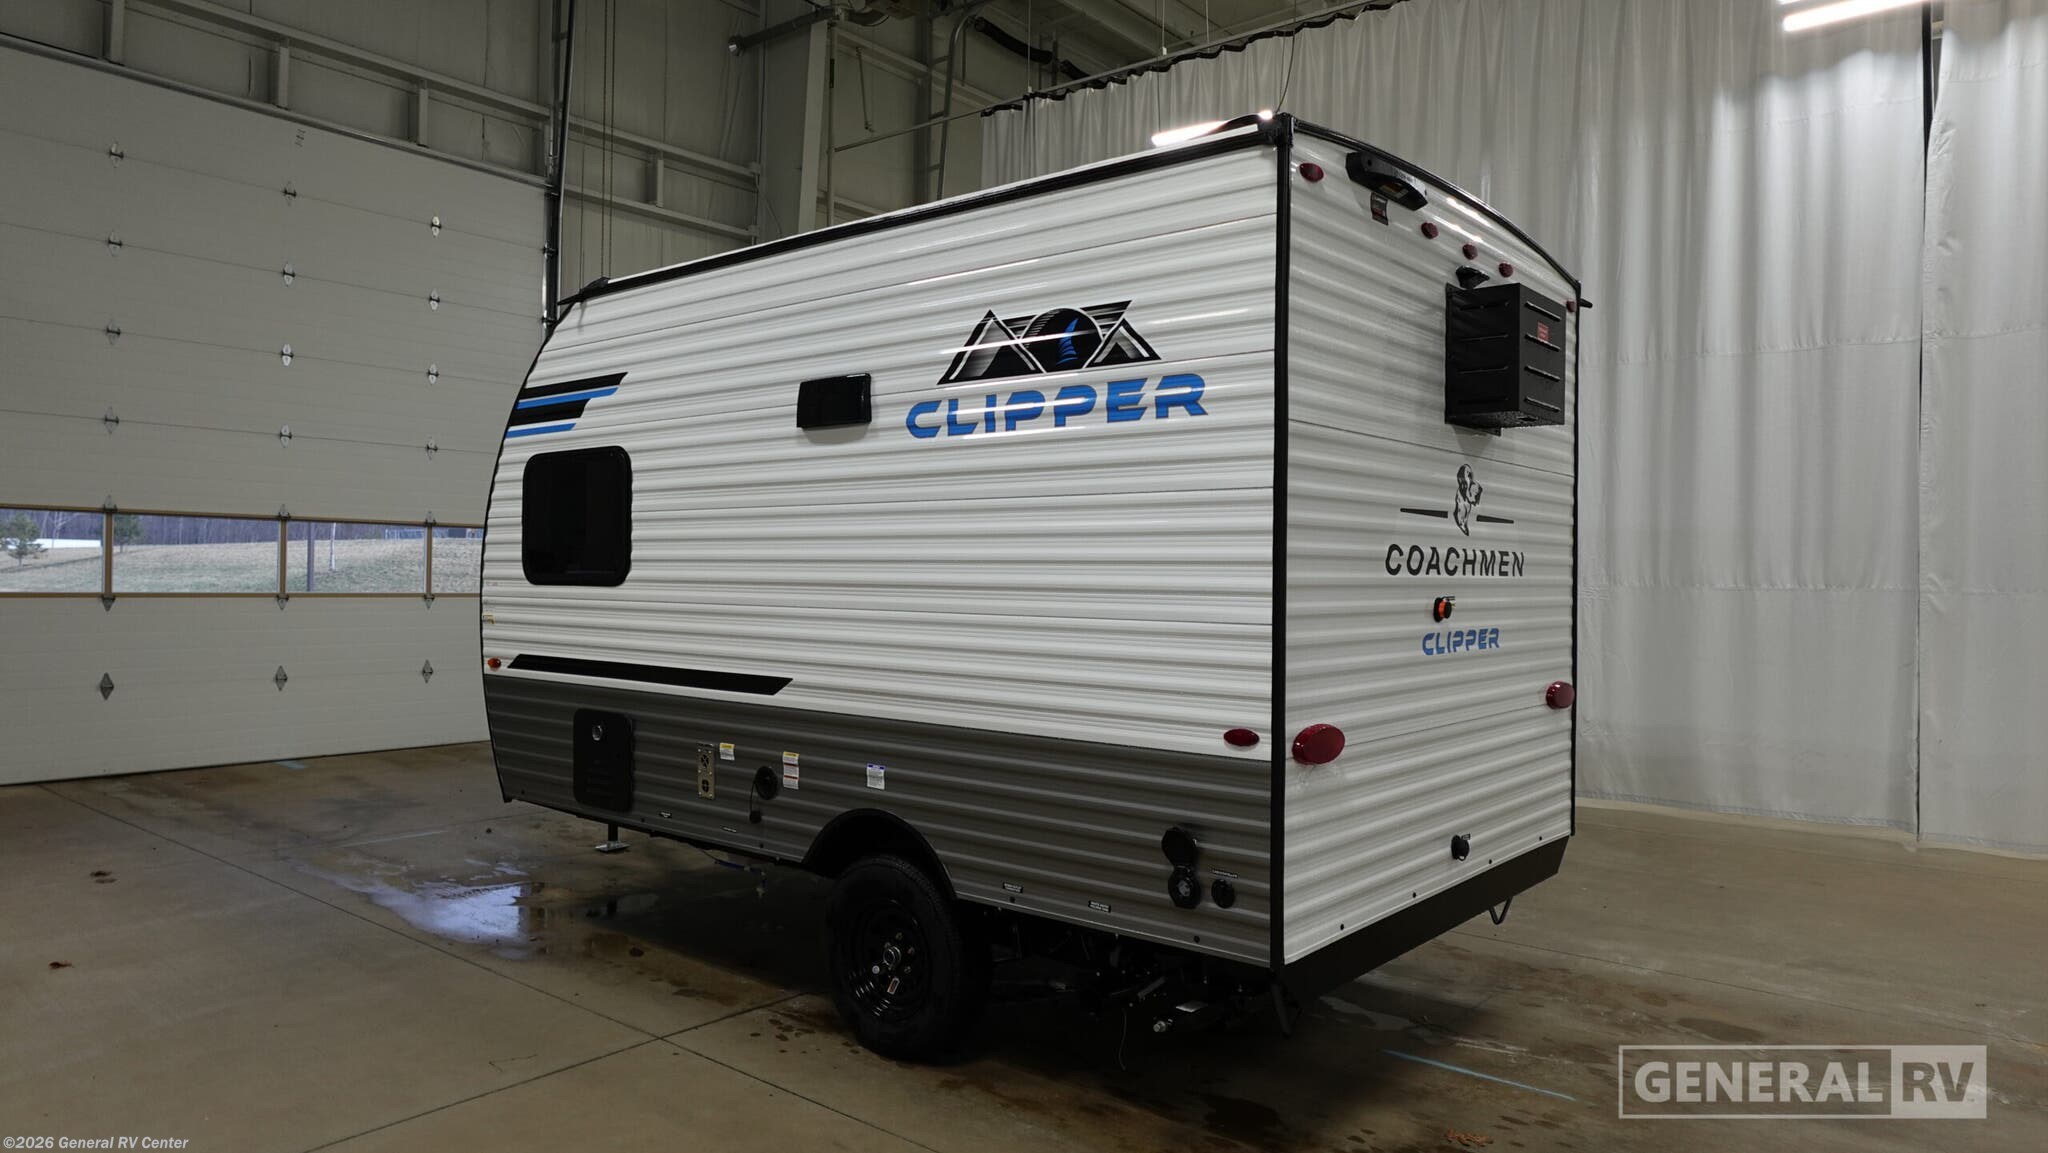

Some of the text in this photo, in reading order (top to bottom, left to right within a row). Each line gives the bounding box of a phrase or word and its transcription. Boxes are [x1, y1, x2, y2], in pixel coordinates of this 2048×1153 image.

[905, 372, 1208, 439] CLIPPER
[1385, 543, 1525, 577] COACHMEN
[1422, 628, 1500, 655] CLIPPER
